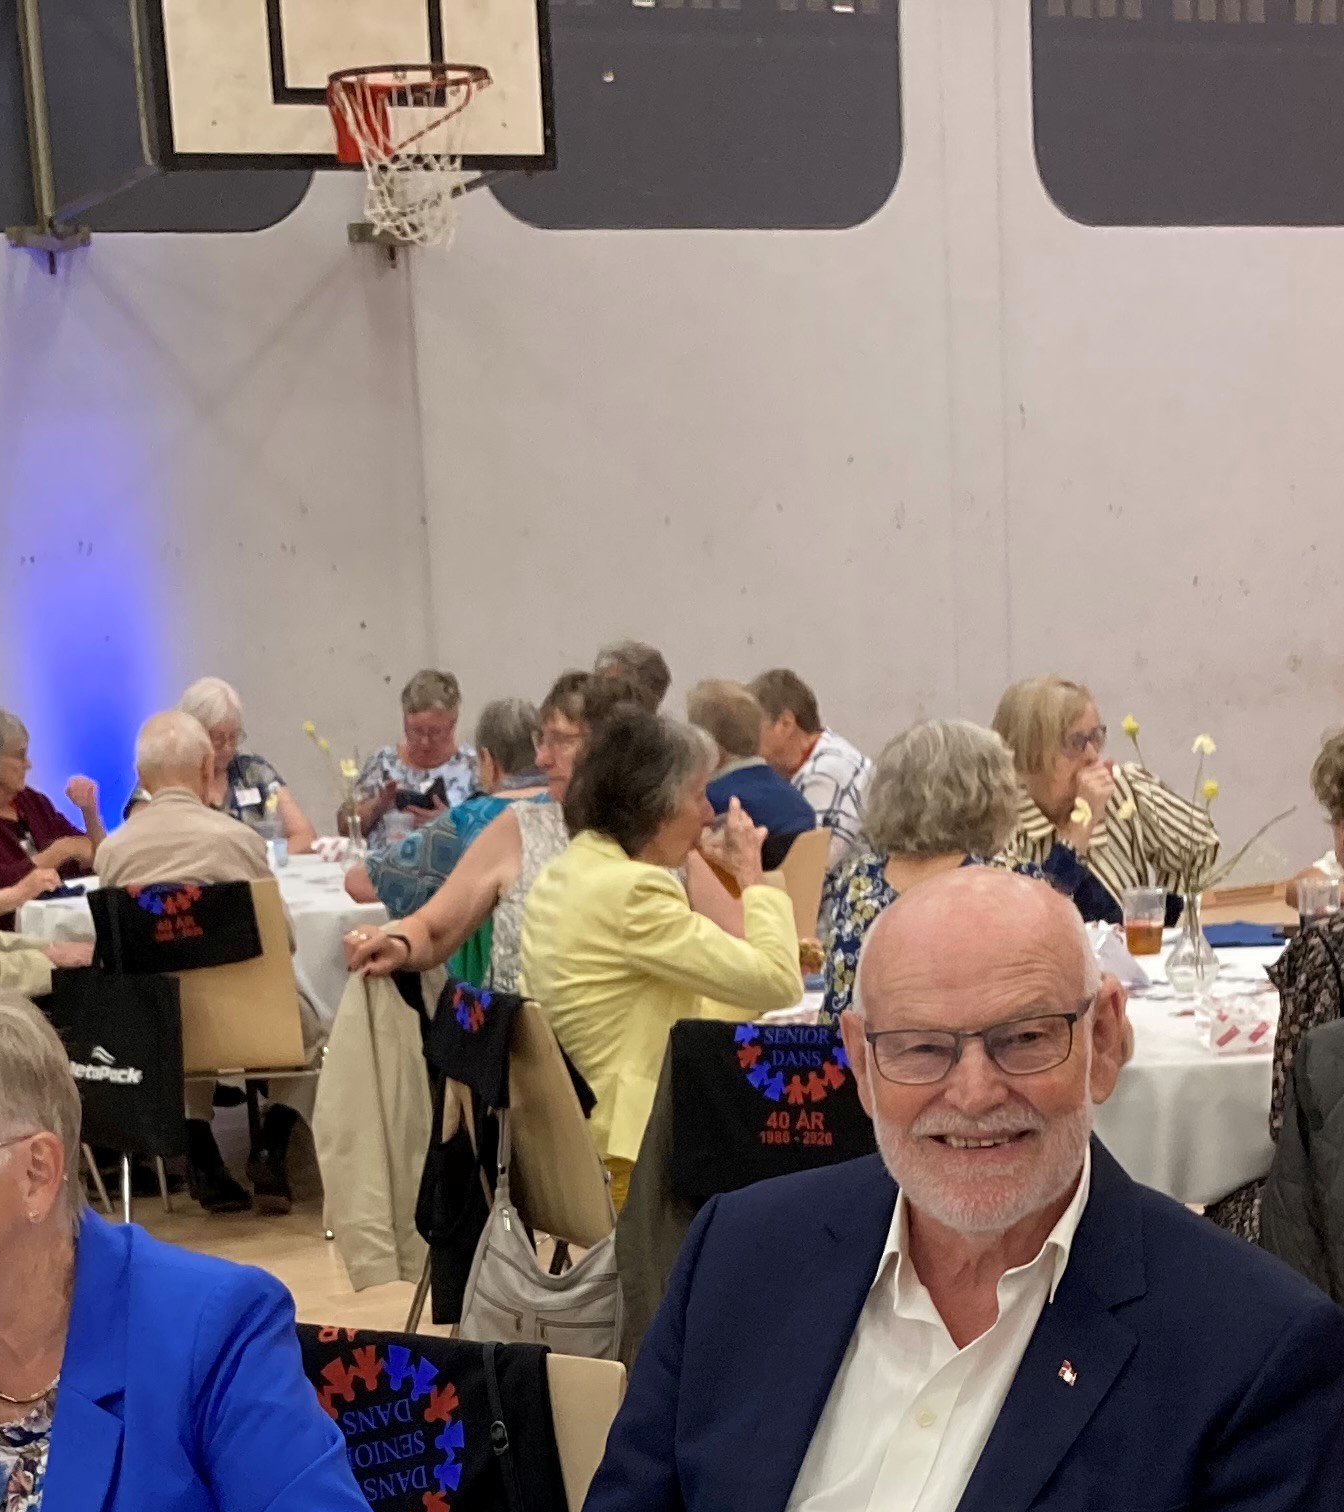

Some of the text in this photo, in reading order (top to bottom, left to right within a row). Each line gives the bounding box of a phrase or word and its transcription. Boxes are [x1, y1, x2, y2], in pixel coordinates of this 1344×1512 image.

[772, 1049, 822, 1067] DANS
[767, 1110, 791, 1130] 40
[342, 1398, 413, 1436] DANS
[357, 1465, 429, 1502] DANS
